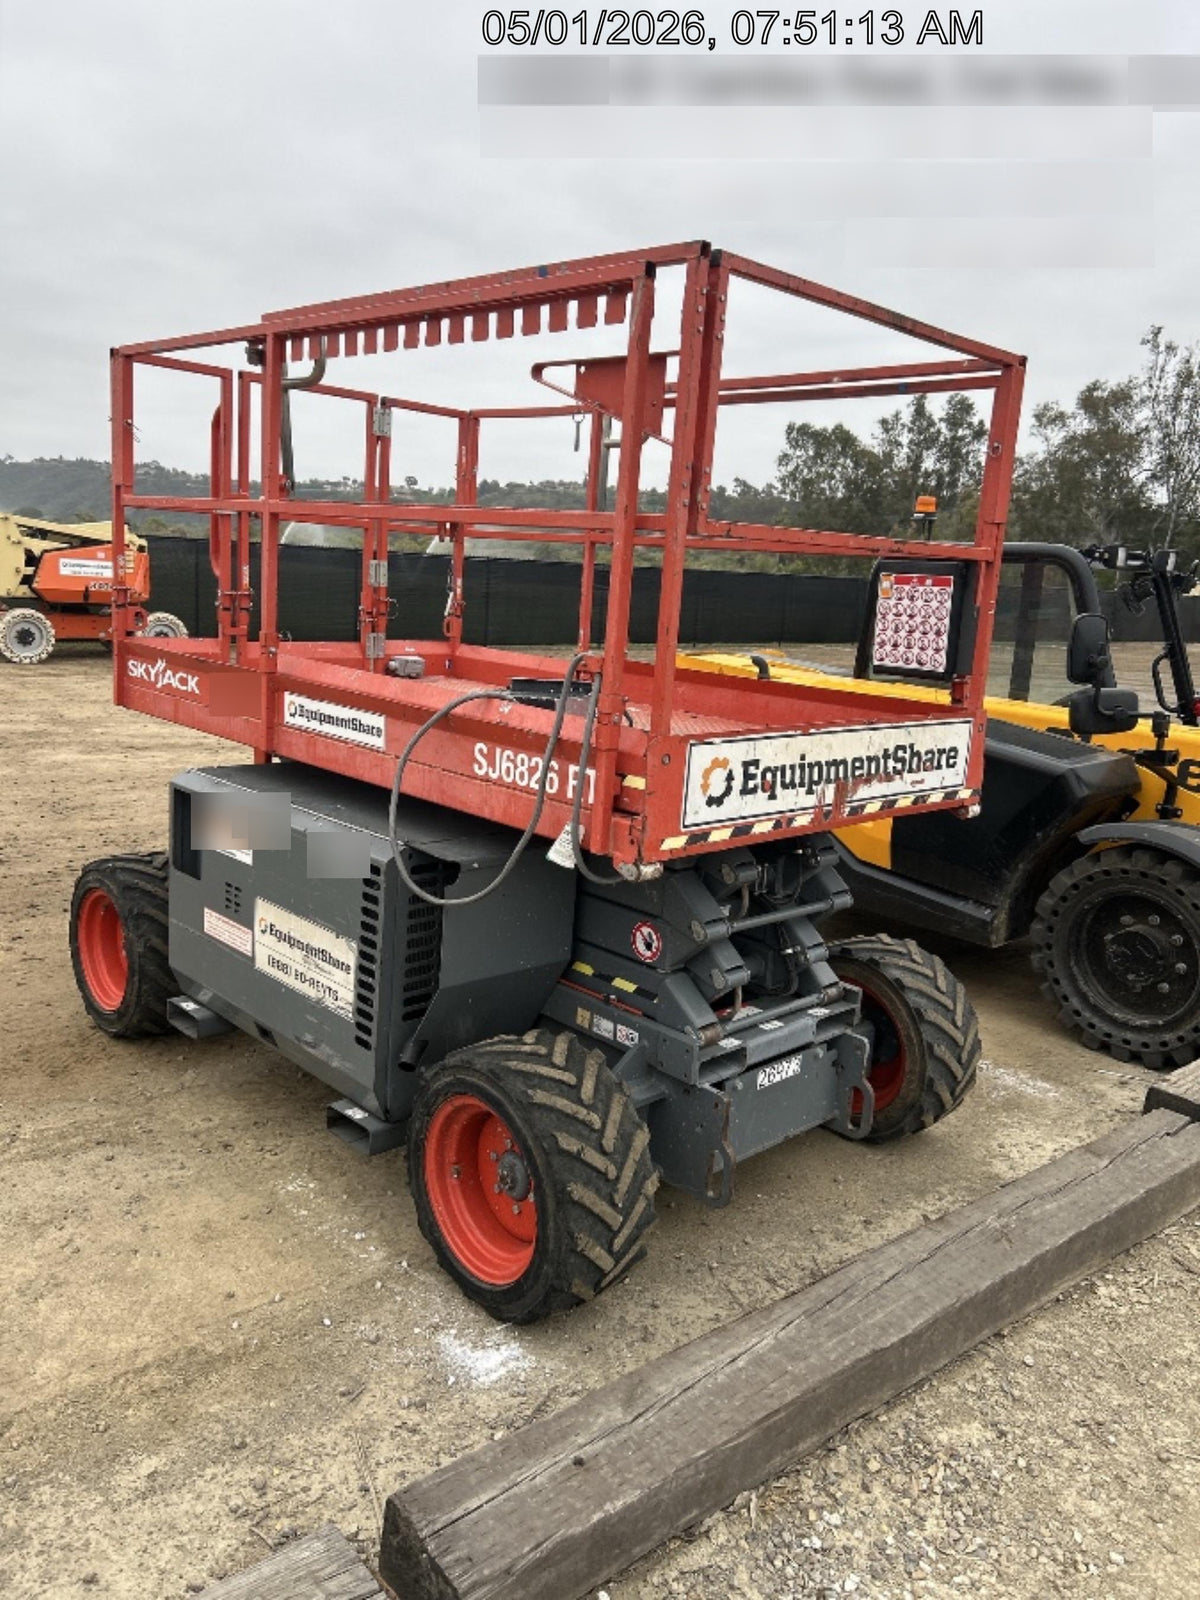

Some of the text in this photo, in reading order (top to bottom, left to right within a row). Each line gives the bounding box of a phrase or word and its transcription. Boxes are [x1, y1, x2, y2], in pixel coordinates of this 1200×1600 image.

[127, 658, 200, 695] SKYJACK
[297, 703, 383, 740] EquipmentShare
[473, 742, 559, 794] SJ6826
[739, 743, 960, 798] EquipmentShare
[269, 922, 352, 975] EquipmentShare
